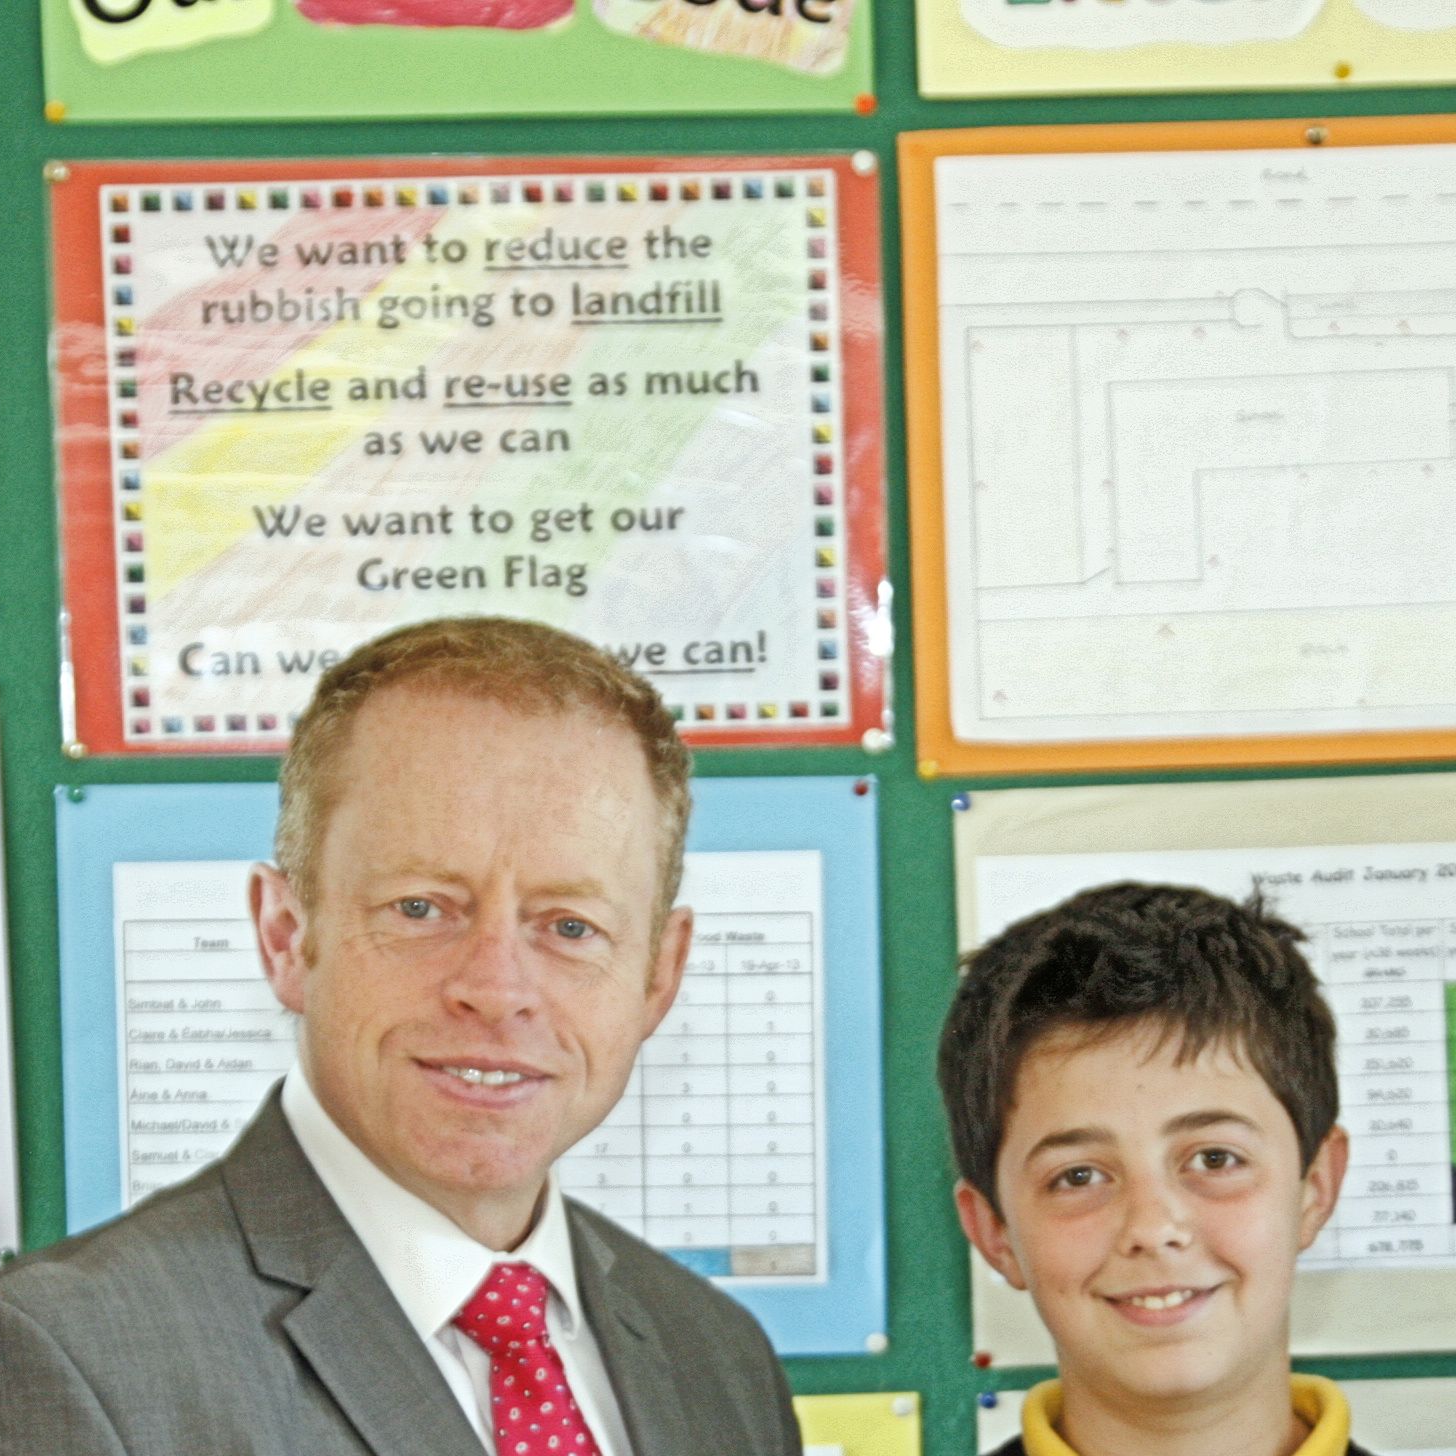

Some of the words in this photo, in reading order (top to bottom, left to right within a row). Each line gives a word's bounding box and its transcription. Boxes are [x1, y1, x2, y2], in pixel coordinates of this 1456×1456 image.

[204, 234, 280, 269] We
[295, 233, 408, 267] want
[424, 233, 467, 264] to
[484, 225, 629, 264] reduce
[646, 224, 713, 260] the
[200, 287, 362, 326] rubbish
[376, 286, 496, 329] going
[511, 287, 555, 318] to
[573, 278, 722, 317] landfill
[168, 366, 332, 412] Recycle
[348, 364, 428, 401] and
[444, 373, 573, 400] re-use
[588, 369, 629, 397] as
[644, 359, 761, 397] much
[363, 428, 404, 457] as
[418, 428, 484, 455] we
[498, 425, 572, 454] can
[253, 504, 327, 540] We
[341, 504, 454, 537] want
[469, 504, 515, 534] to
[529, 503, 595, 543] get
[609, 504, 686, 533] our
[357, 558, 488, 592] Green
[503, 555, 590, 598] Flag
[178, 640, 262, 678] Can
[276, 645, 341, 674] we
[681, 630, 768, 666] can!
